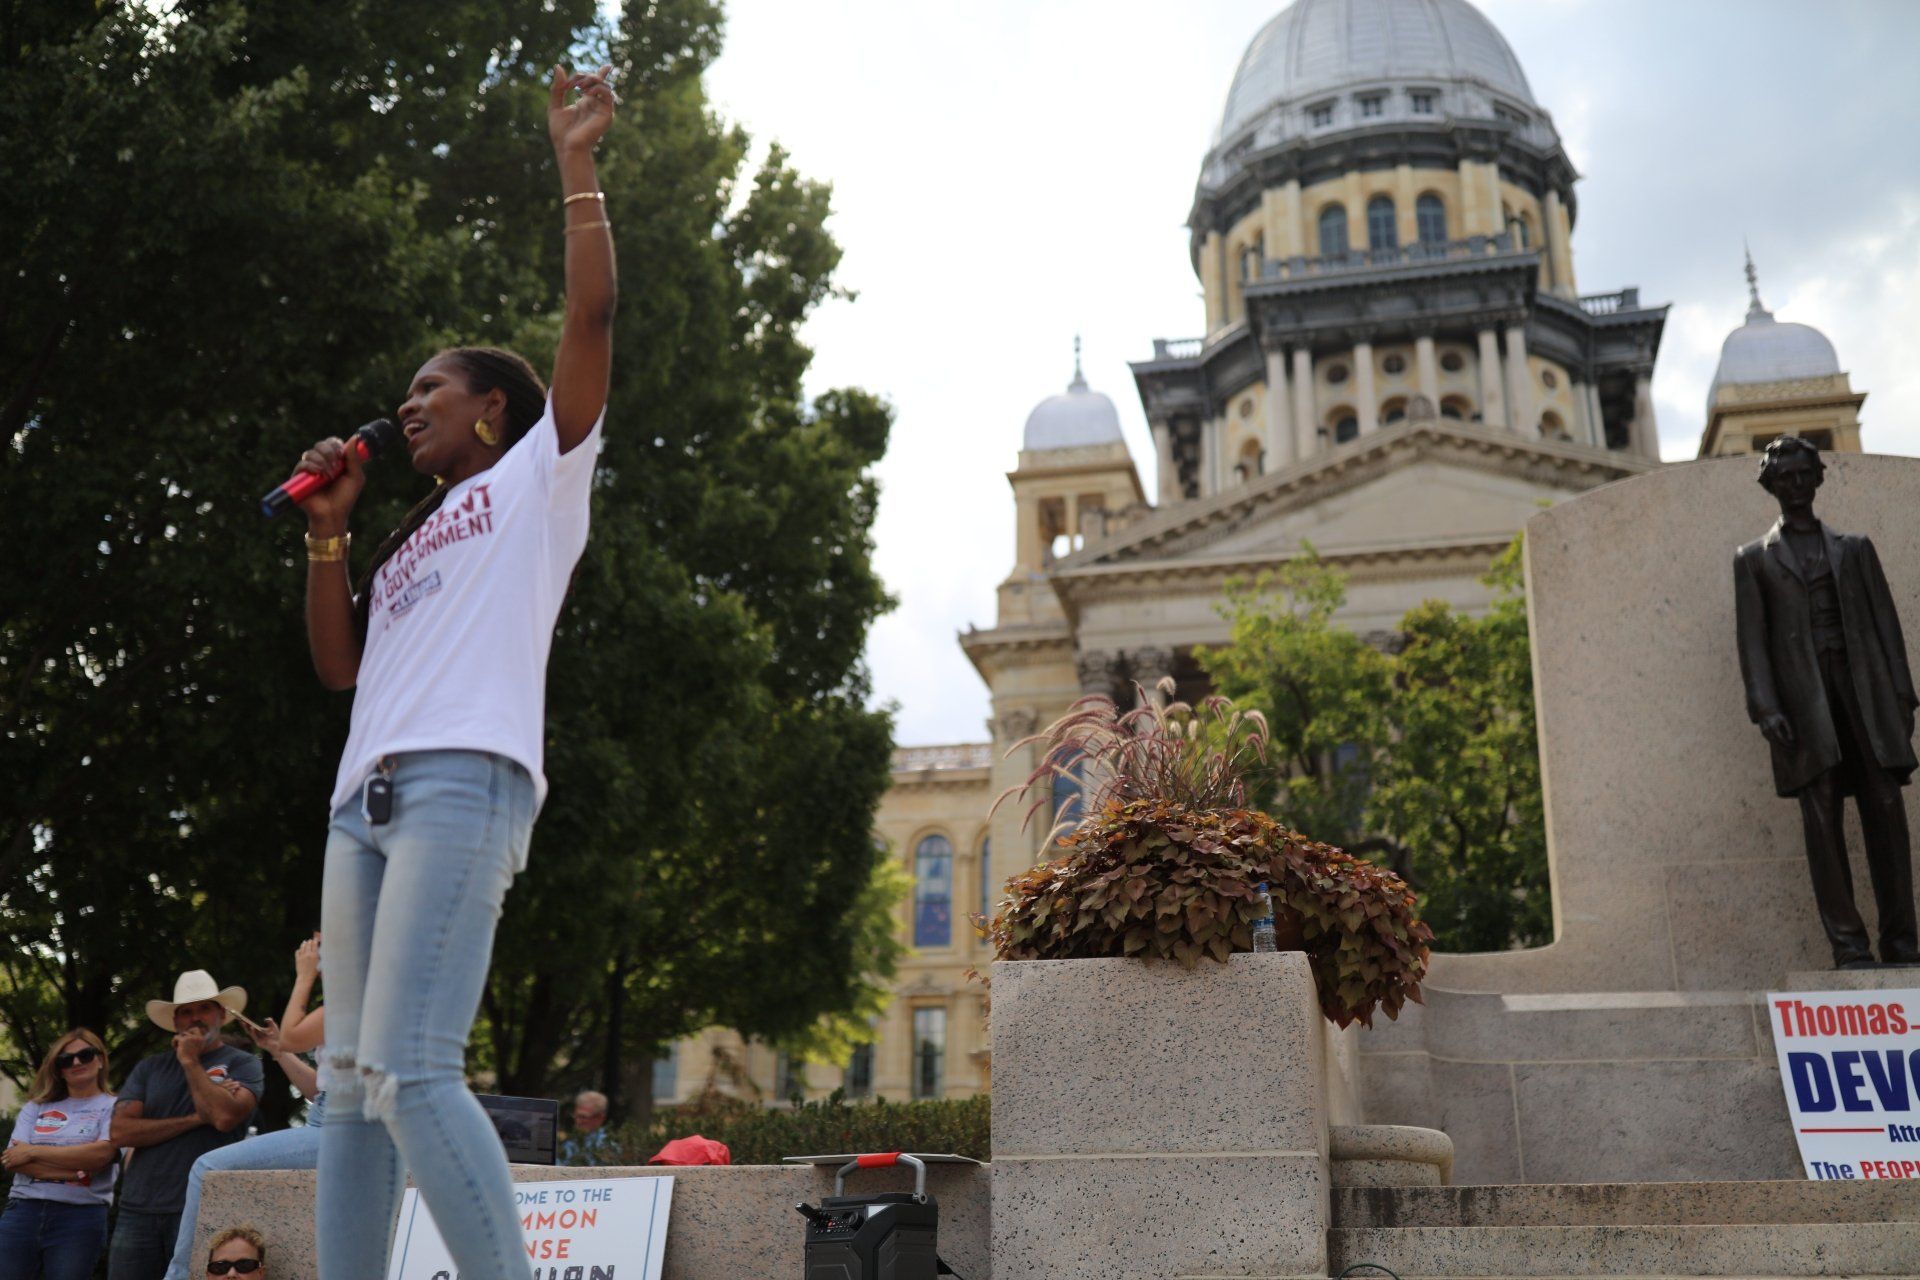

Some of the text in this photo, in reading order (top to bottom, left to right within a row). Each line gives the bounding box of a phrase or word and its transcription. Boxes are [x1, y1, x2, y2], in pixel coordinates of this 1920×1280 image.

[384, 511, 493, 599] GOVERNMENT
[1774, 1000, 1908, 1037] Thomas
[1787, 1049, 1920, 1113] DEV
[1810, 1161, 1855, 1180] The
[555, 1189, 576, 1203] TO
[583, 1188, 613, 1202] THE
